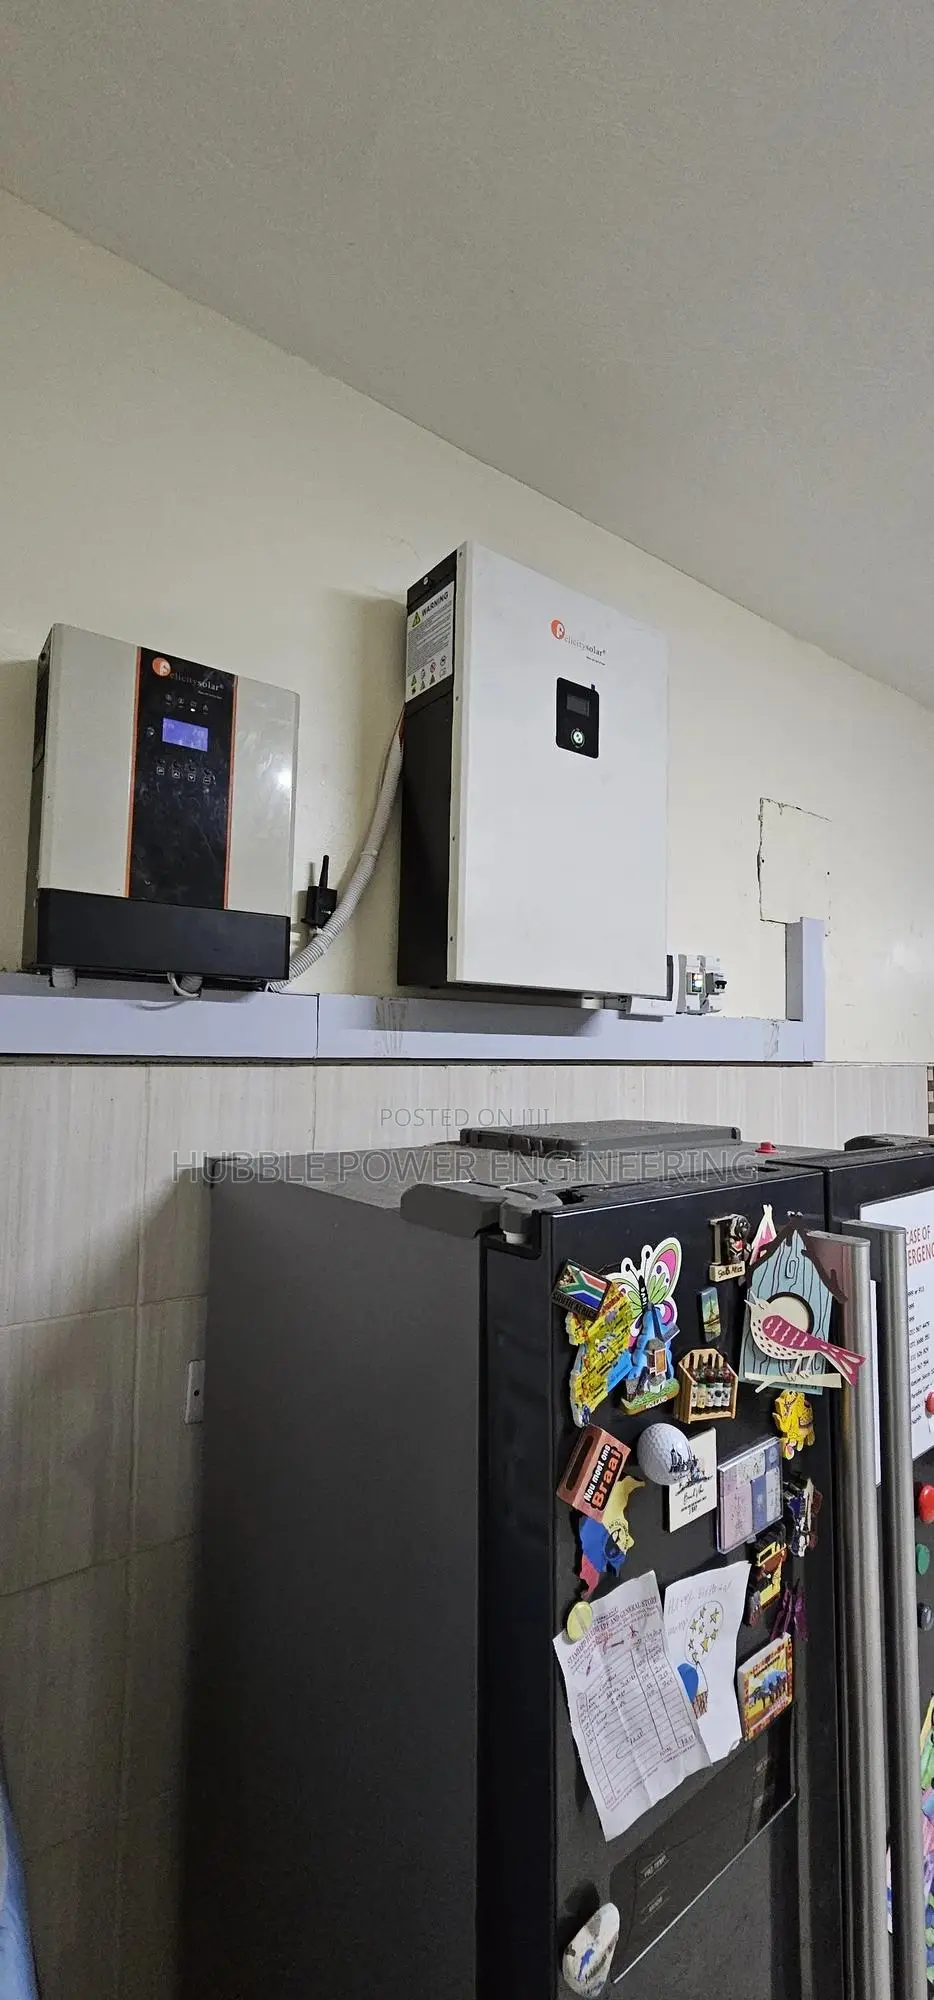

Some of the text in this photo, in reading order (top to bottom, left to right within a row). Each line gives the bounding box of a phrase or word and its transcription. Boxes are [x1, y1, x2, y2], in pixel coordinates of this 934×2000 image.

[421, 591, 449, 617] WARNING
[922, 1225, 931, 1240] OF
[583, 1483, 597, 1502] Nou
[601, 1444, 612, 1461] ons
[591, 1448, 621, 1507] Braai
